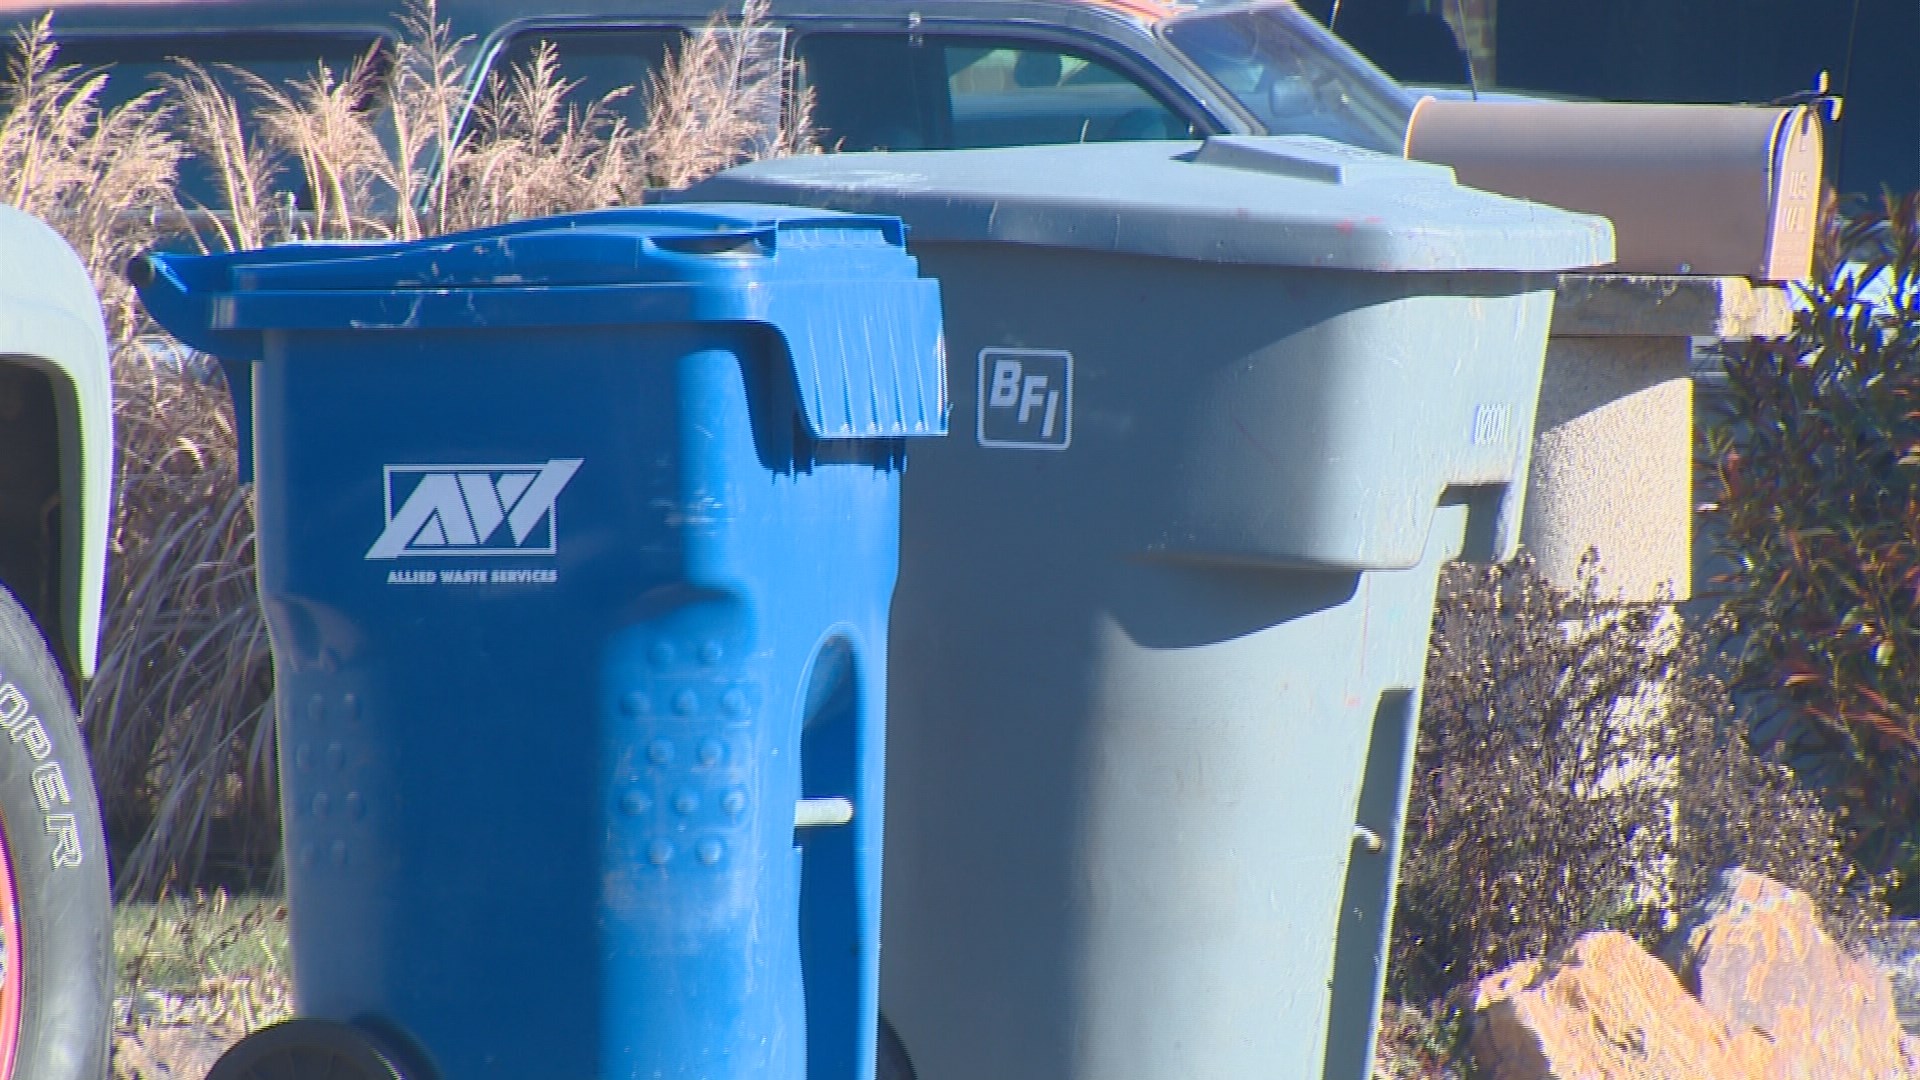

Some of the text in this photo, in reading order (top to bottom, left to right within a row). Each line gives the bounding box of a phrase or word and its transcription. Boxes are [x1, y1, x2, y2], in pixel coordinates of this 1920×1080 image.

[989, 360, 1059, 438] BFI
[387, 570, 558, 584] ALLIED WASTE SERVICES
